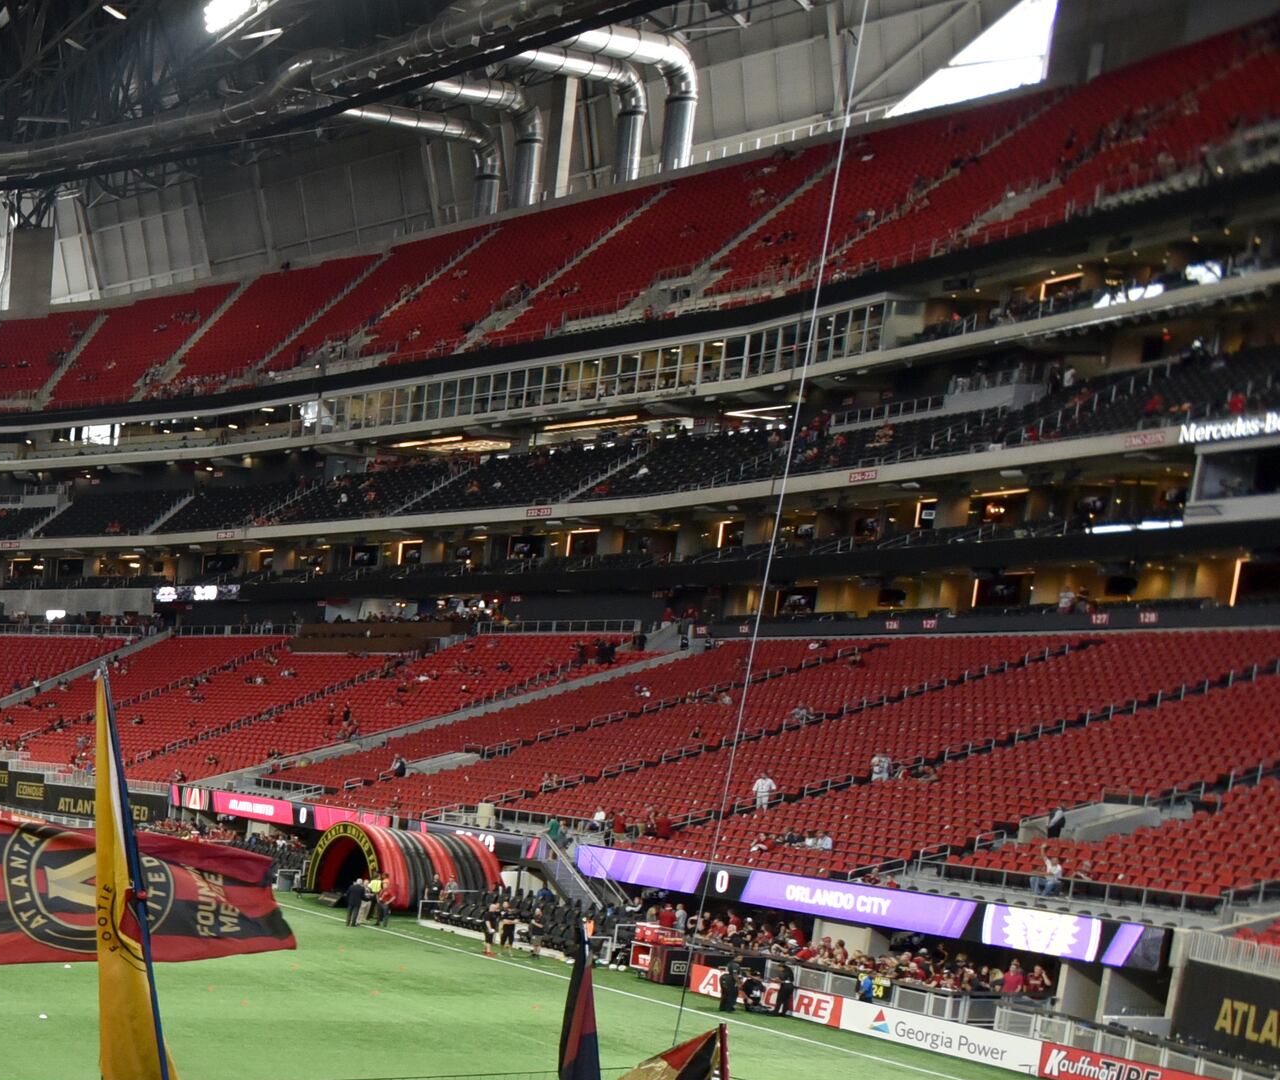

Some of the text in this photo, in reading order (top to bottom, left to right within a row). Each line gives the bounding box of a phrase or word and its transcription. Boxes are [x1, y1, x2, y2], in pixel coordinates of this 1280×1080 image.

[922, 619, 936, 629] 127
[1092, 614, 1108, 624] 127
[17, 783, 45, 798] CONQUE
[133, 805, 148, 821] TED
[299, 807, 307, 824] 0
[11, 832, 39, 930] ATLANTA
[715, 870, 730, 894] 0
[785, 884, 892, 916] ORLANDO CITY
[98, 883, 120, 953] FOOTIE
[1214, 997, 1280, 1047] ATLA
[894, 1020, 1008, 1062] Georgia Power
